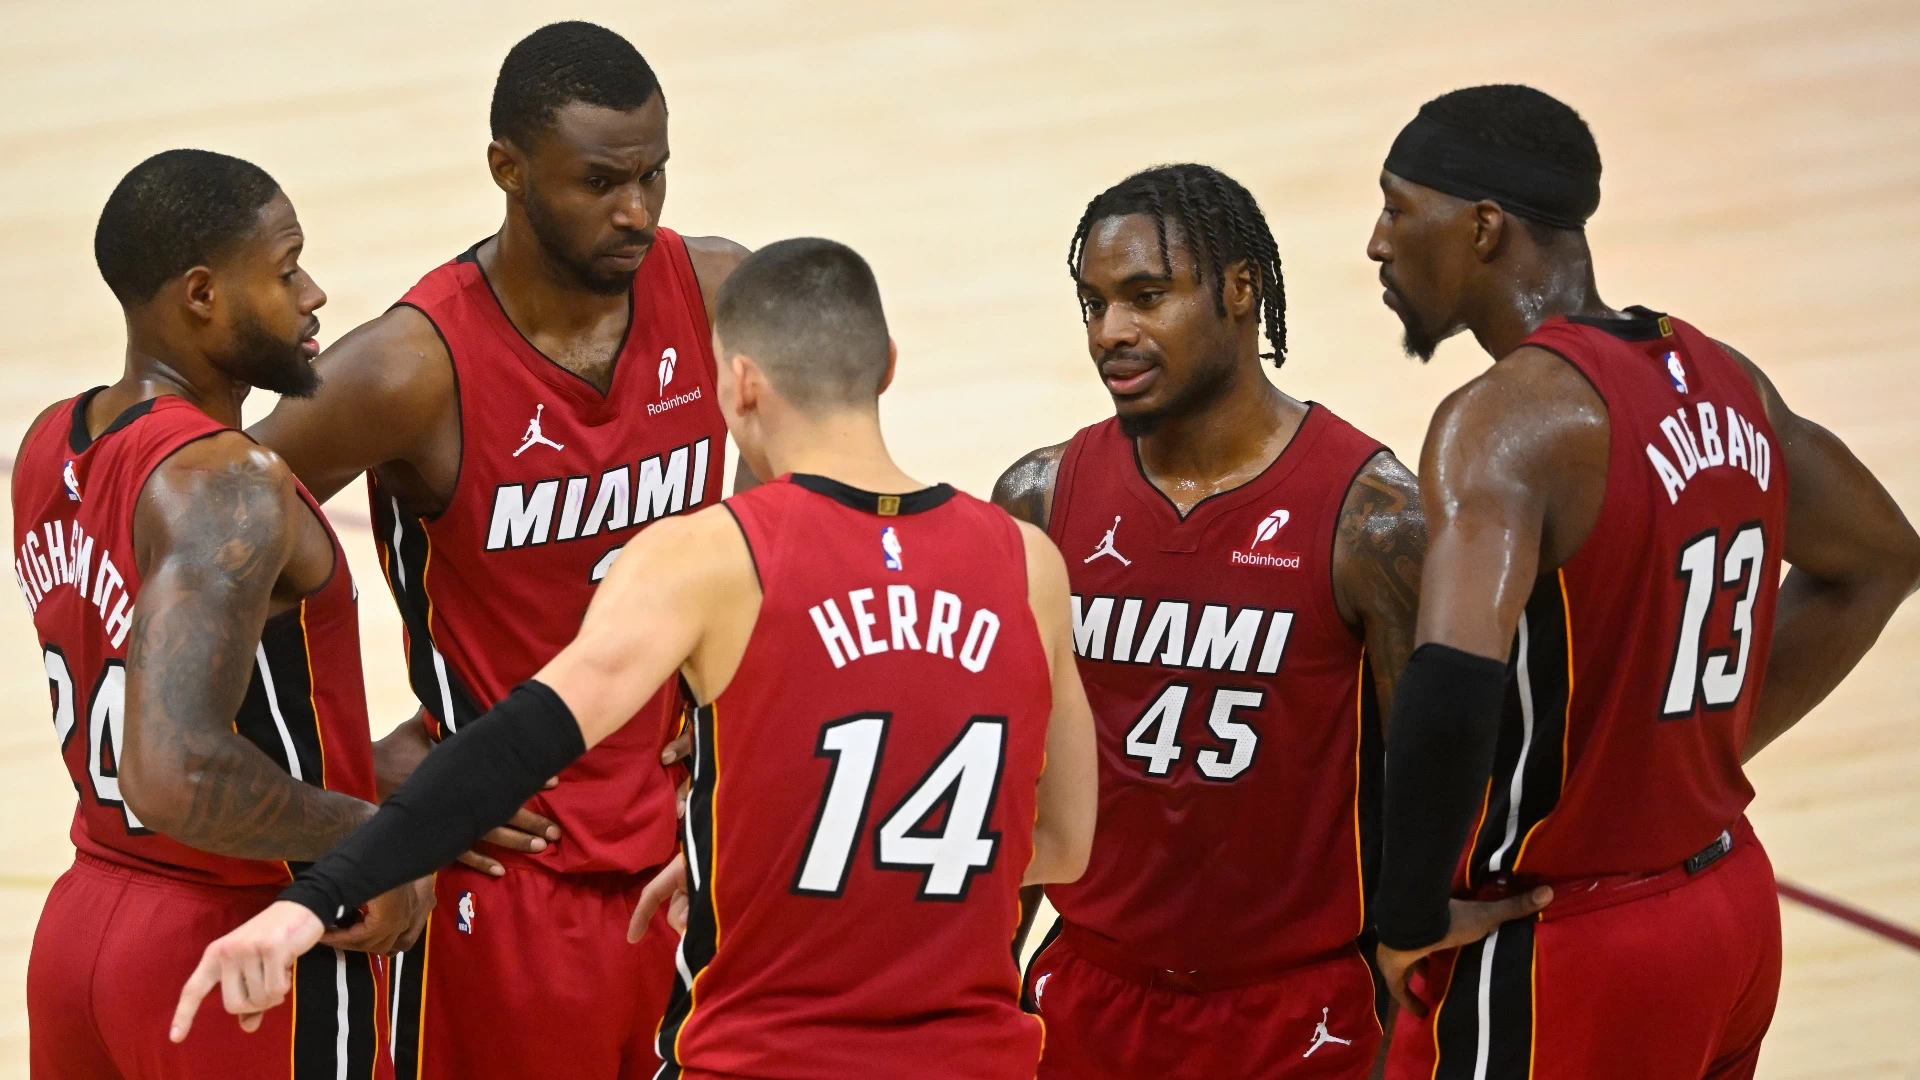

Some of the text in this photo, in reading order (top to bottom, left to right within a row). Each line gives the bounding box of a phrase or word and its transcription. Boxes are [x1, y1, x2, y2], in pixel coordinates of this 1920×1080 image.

[647, 386, 702, 416] Robinhood
[484, 437, 711, 552] MIAMI
[1646, 401, 1771, 505] ADEBAYO
[1231, 551, 1300, 569] Robinhood
[808, 584, 1001, 673] HERRO
[1070, 593, 1295, 675] MIAMI
[1659, 521, 1767, 719] 13
[1123, 682, 1266, 782] 45
[792, 712, 1007, 901] 14
